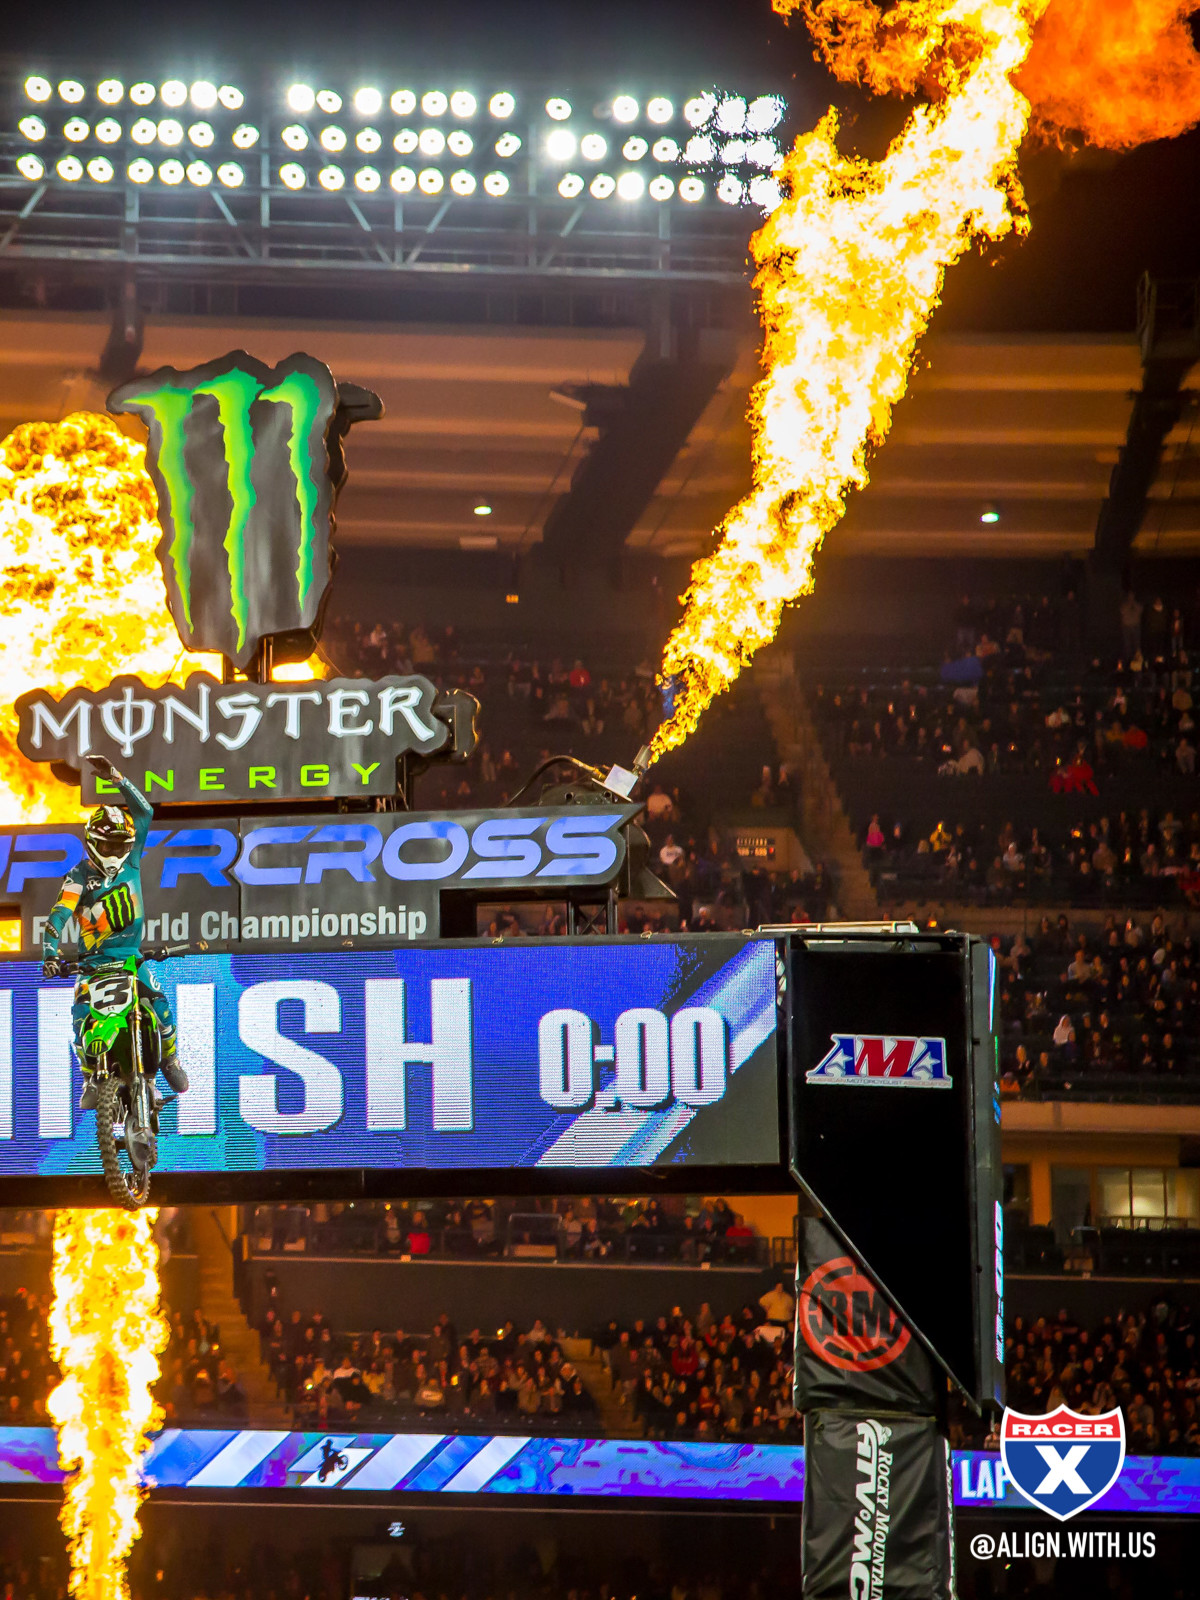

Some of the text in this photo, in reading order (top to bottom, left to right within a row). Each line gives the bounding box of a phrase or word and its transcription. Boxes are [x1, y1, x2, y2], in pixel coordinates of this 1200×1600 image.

[29, 683, 435, 758] MONSTER
[200, 904, 428, 943] Championship
[94, 978, 130, 1010] 3
[538, 1007, 727, 1108] 0:00
[806, 1034, 952, 1080] AMA
[876, 1449, 893, 1509] ROCKY
